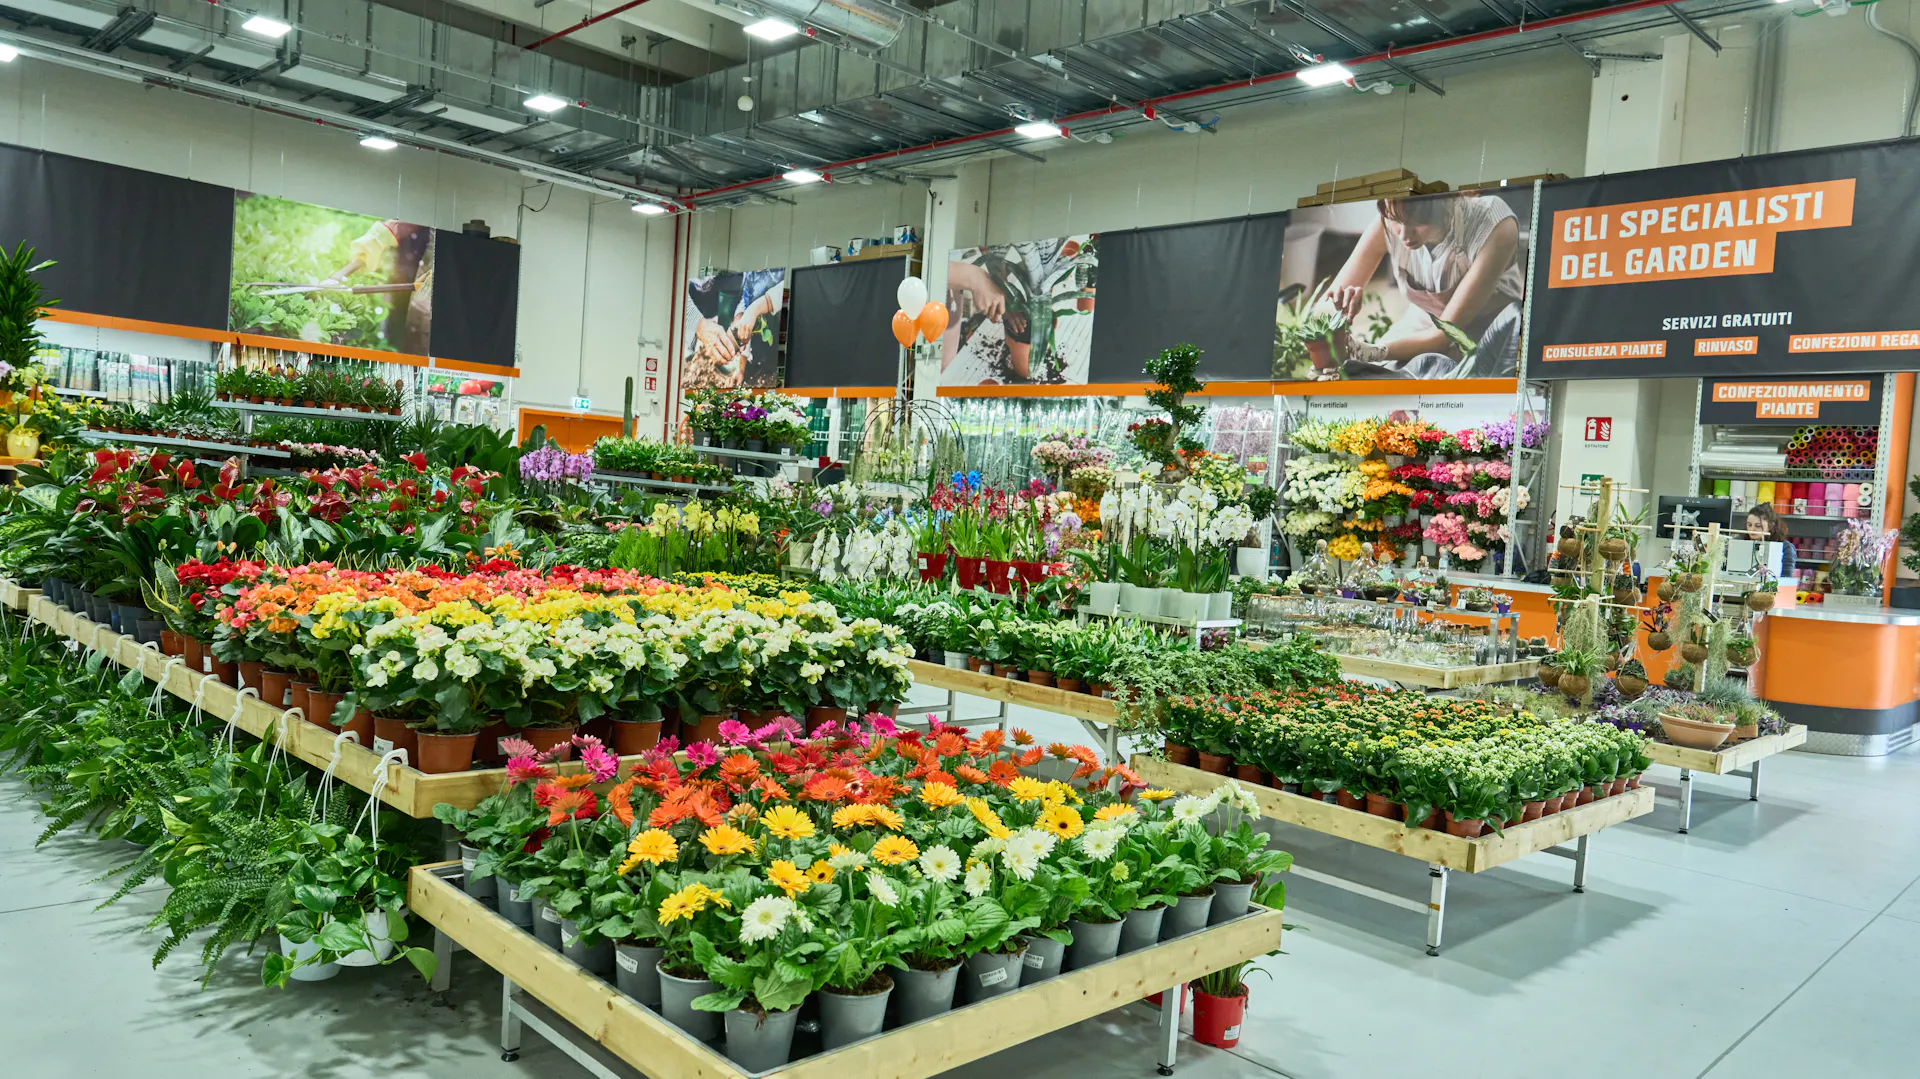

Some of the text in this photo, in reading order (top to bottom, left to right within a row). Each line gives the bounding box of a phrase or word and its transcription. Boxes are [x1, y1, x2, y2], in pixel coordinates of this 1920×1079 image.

[1563, 190, 1824, 243] GLI SPECIALISTI
[1560, 238, 1757, 281] DEL GARDEN
[1661, 311, 1793, 331] SERVIZI GRATUITI
[1545, 342, 1664, 359] CONSULENZA PIANTE
[1697, 339, 1754, 353] RINVASO
[1792, 335, 1877, 350] CONFEZIONI
[1718, 384, 1865, 399] CONFEZIONAMENTO
[1761, 402, 1814, 415] PIANTE
